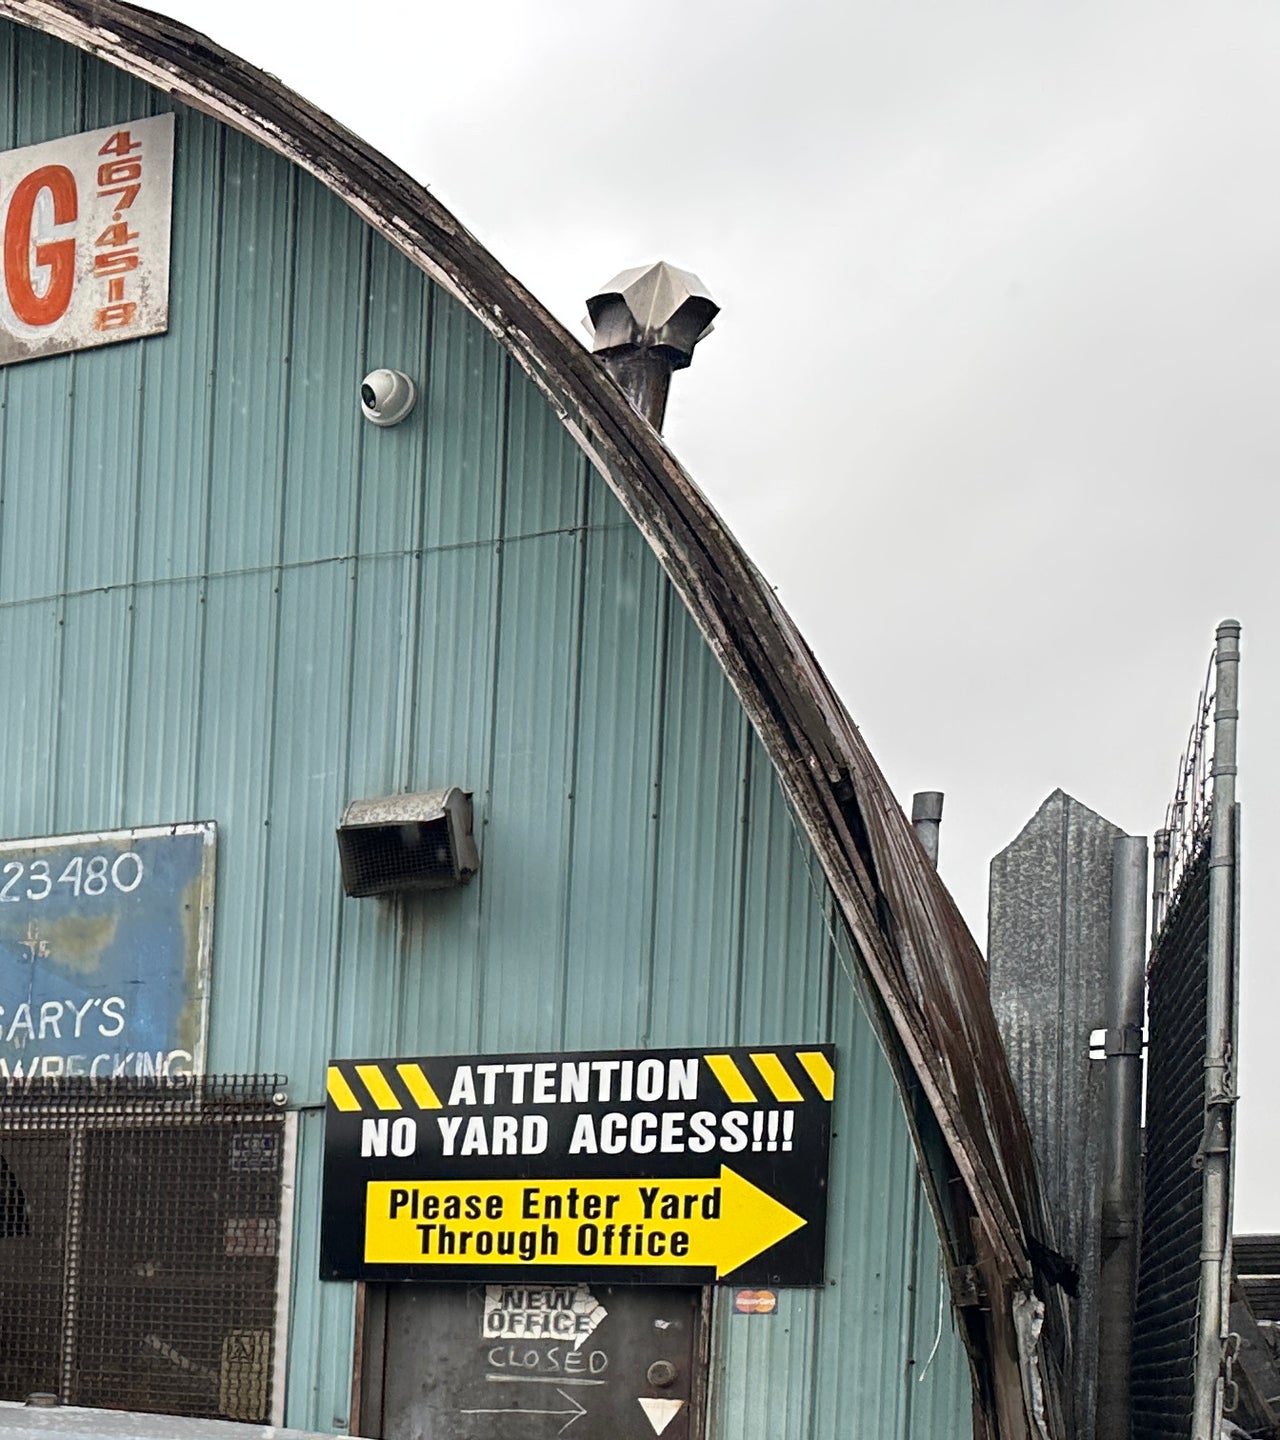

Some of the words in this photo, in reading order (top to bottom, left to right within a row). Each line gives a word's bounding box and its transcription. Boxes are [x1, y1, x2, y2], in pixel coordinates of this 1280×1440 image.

[0, 852, 144, 902] 23480
[448, 1058, 699, 1106] ATTENTION
[360, 1115, 416, 1157] NO
[437, 1114, 549, 1156] YARD
[570, 1110, 794, 1155] ACCESS!!!
[389, 1187, 504, 1219] Please
[522, 1187, 620, 1219] Enter
[640, 1186, 721, 1219] Yard
[416, 1223, 559, 1261] Through
[577, 1223, 690, 1257] Office
[501, 1288, 576, 1311] NEW
[486, 1309, 592, 1334] OFFICE
[488, 1346, 609, 1375] CLOSED
